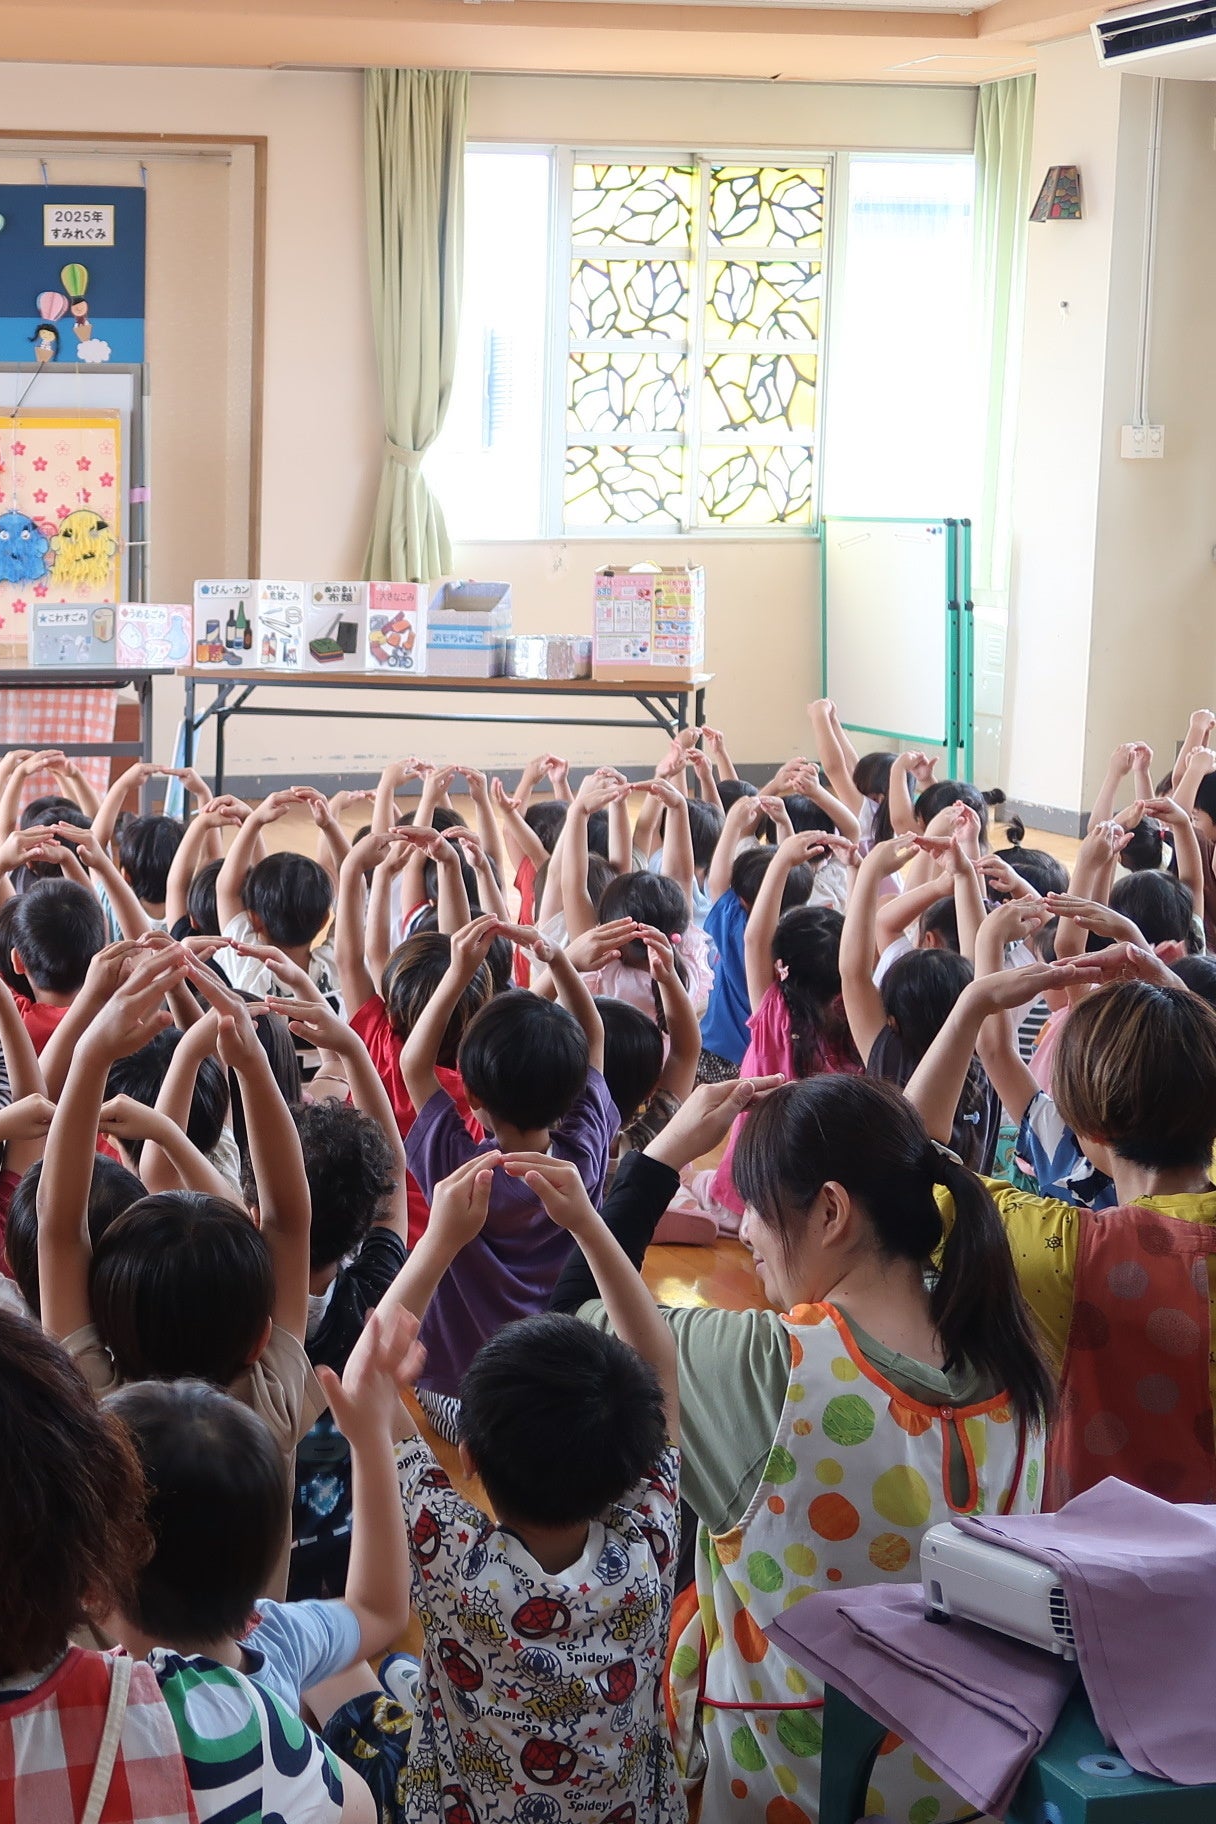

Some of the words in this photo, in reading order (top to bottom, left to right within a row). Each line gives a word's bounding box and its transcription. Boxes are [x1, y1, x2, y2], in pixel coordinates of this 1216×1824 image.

[55, 211, 103, 222] 2025年
[51, 228, 106, 240] すみれぐみ
[211, 585, 249, 594] びん・カン
[48, 614, 86, 623] こわすごみ
[556, 1641, 579, 1651] Go-
[566, 1652, 613, 1666] Spidey!
[481, 1706, 533, 1724] Spidey!
[564, 1790, 584, 1800] Go-
[568, 1800, 613, 1813] Spidey!
